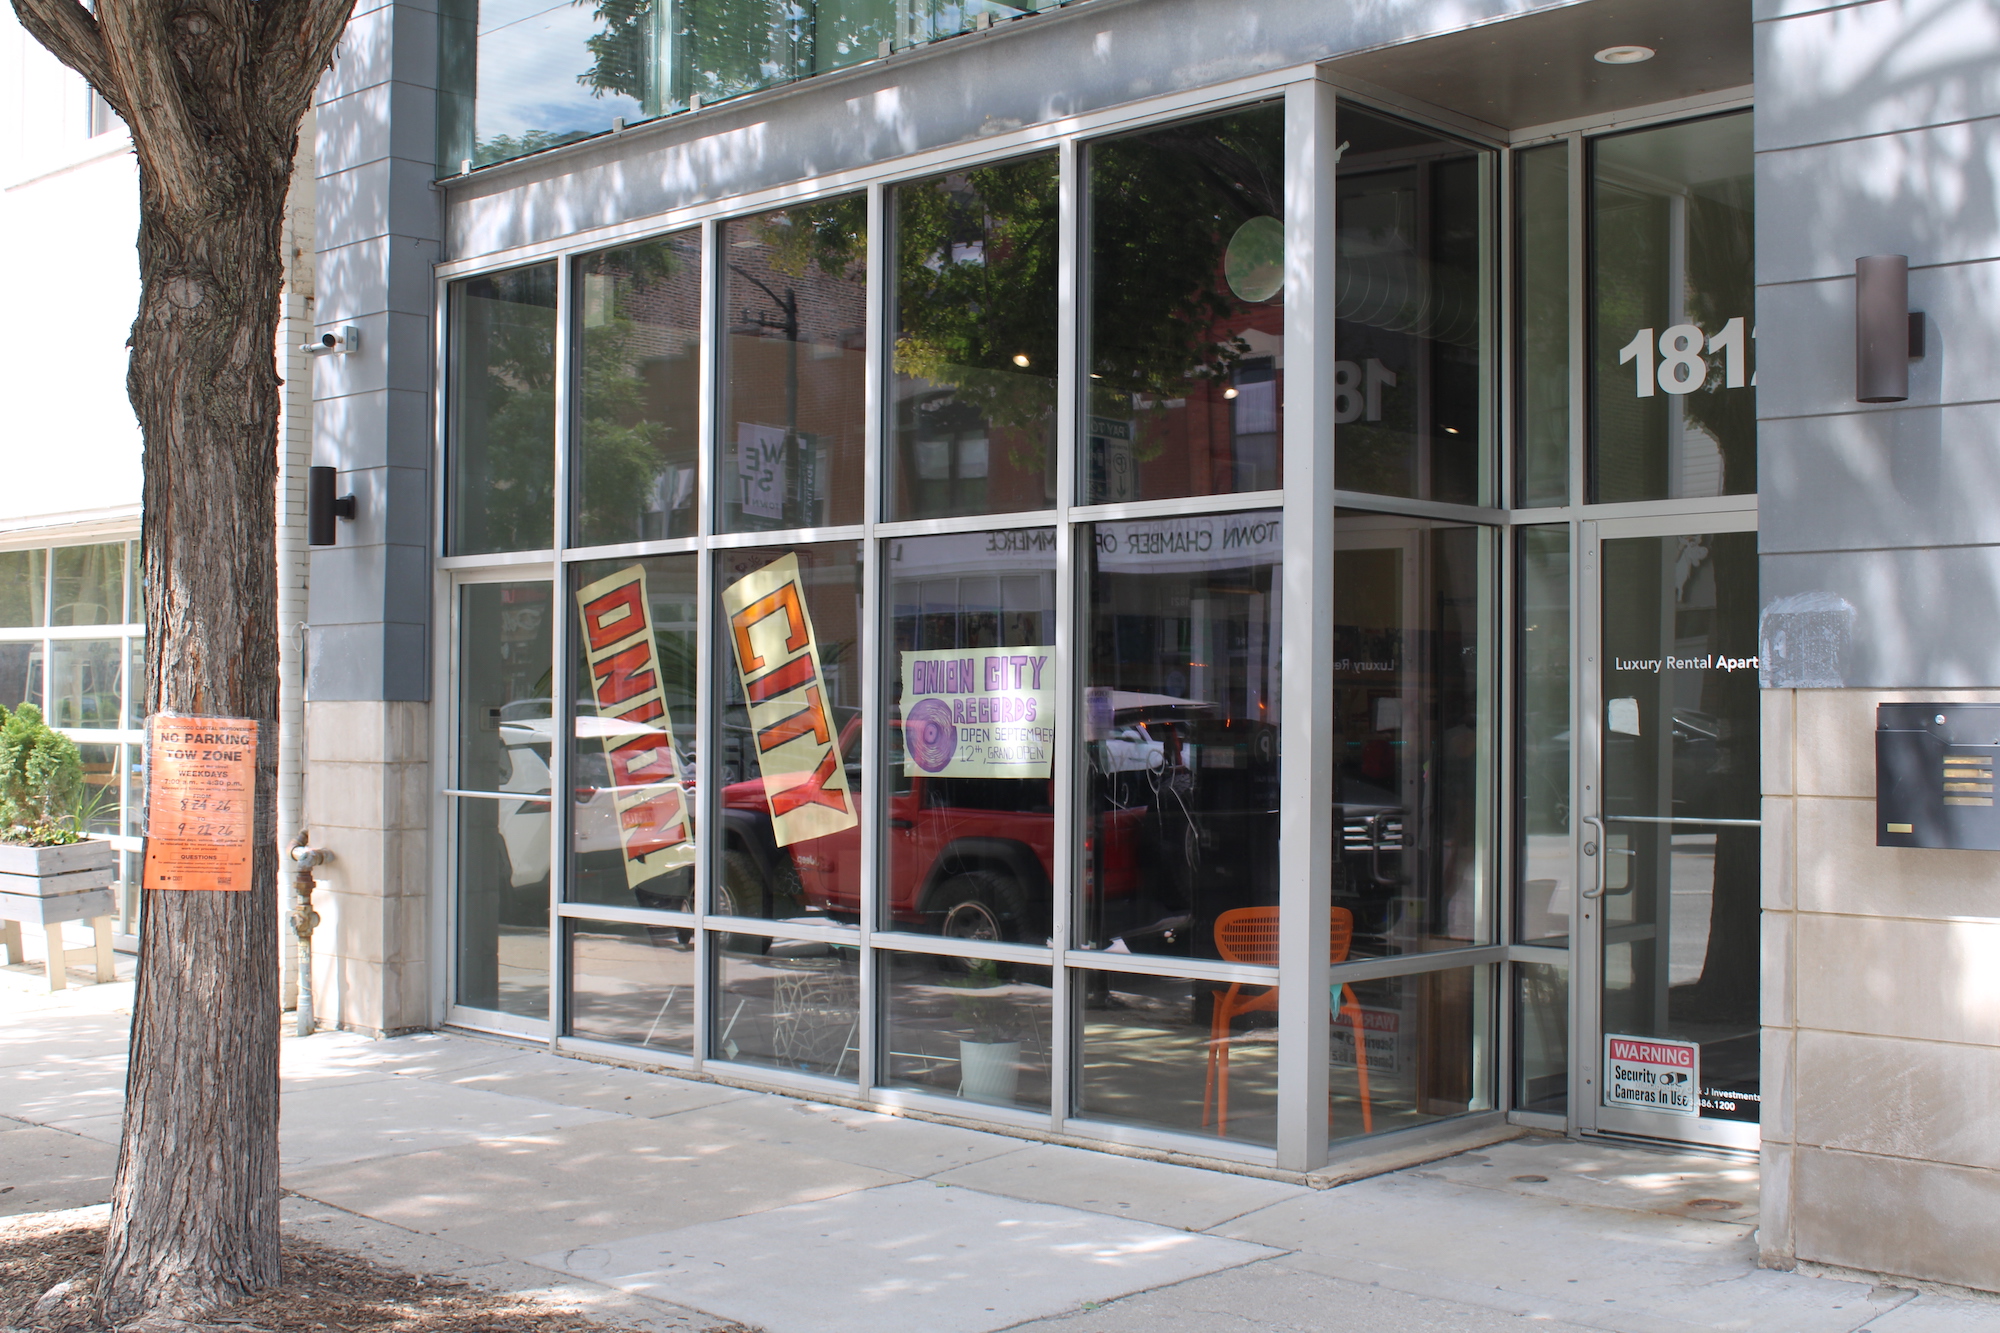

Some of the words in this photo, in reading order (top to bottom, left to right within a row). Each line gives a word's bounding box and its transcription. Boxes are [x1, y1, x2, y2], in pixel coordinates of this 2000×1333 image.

[1620, 317, 1756, 397] 181
[1615, 656, 1662, 674] Luxury
[1666, 654, 1712, 670] Rental
[913, 658, 975, 695] ONION
[984, 655, 1048, 692] CITY
[731, 579, 848, 817] CITY
[583, 579, 686, 861] ONION
[953, 697, 1037, 724] RECORDS
[161, 732, 179, 742] NO
[184, 733, 249, 745] PARKING
[961, 728, 991, 743] OPEN
[994, 727, 1054, 744] SEPTEMBER
[166, 750, 197, 759] TOW
[202, 750, 242, 761] ZONE
[1017, 746, 1044, 760] OPEN
[178, 770, 229, 778] WEEKDAYS
[1614, 1042, 1690, 1065] WARNING
[1615, 1065, 1656, 1084] Security
[1615, 1084, 1656, 1103] Cameras
[1659, 1089, 1668, 1104] In
[1671, 1091, 1688, 1107] Use
[1704, 1087, 1710, 1096] J
[1711, 1088, 1761, 1103] Investments
